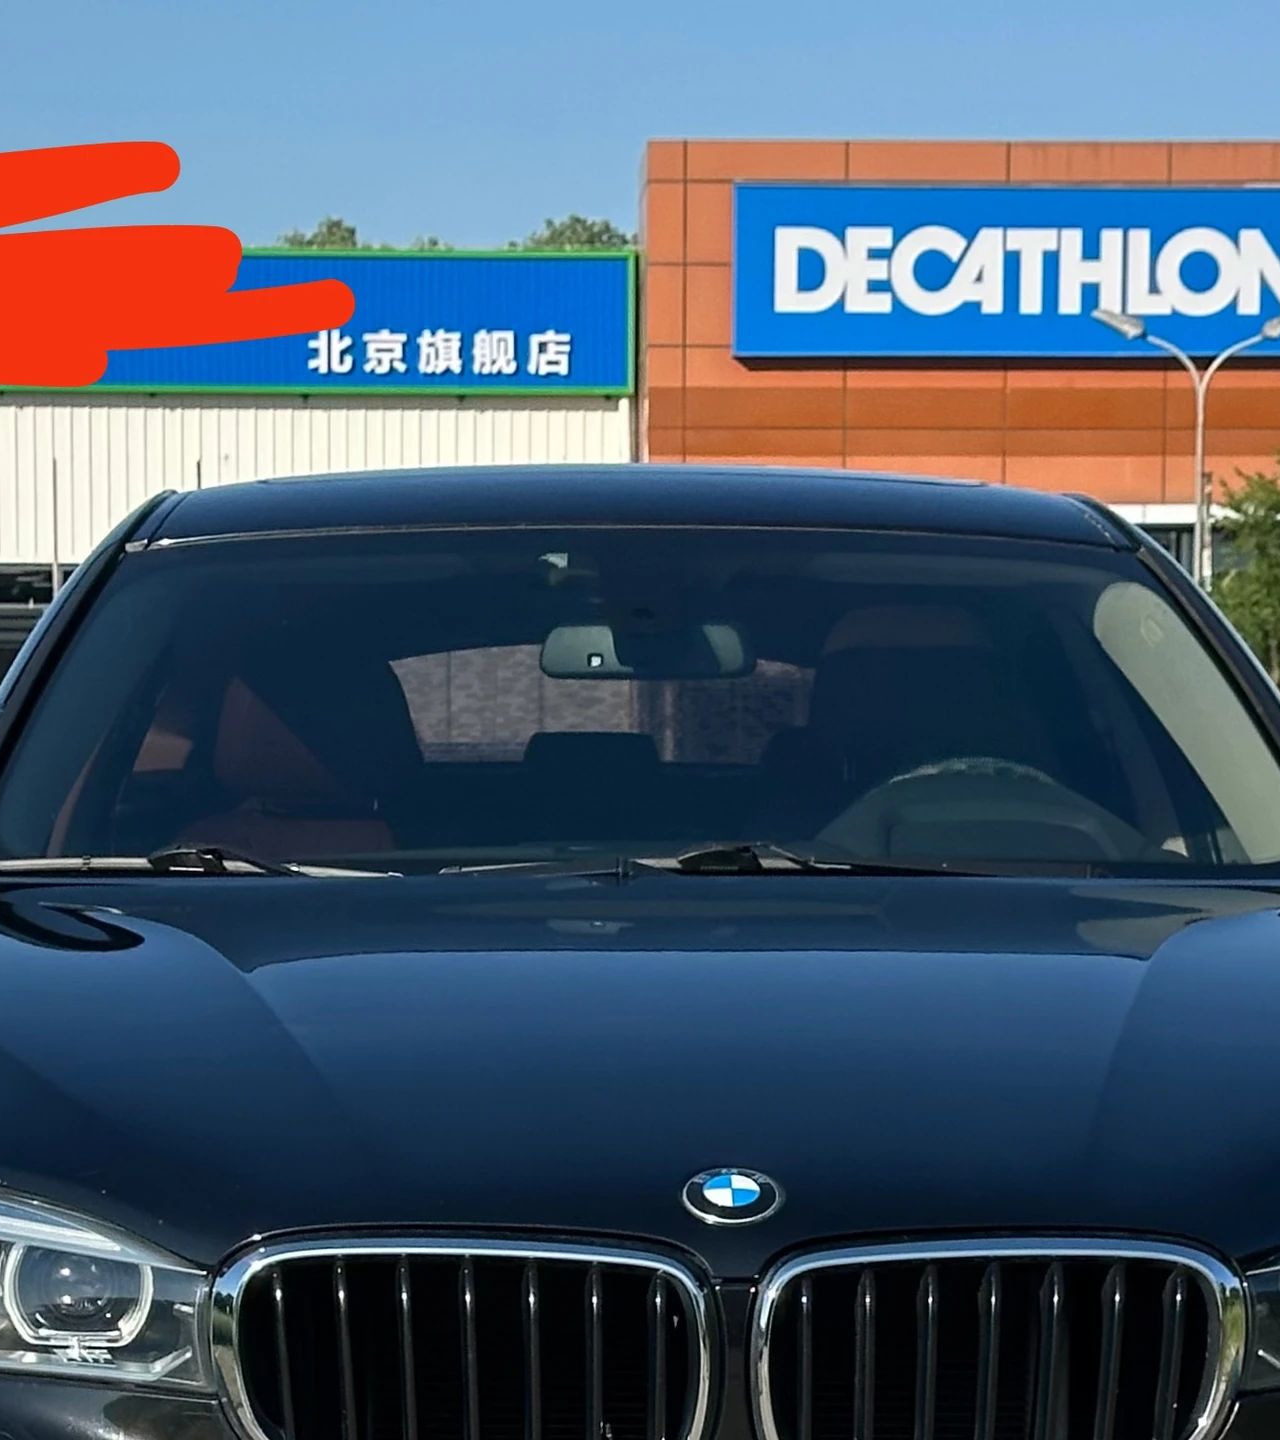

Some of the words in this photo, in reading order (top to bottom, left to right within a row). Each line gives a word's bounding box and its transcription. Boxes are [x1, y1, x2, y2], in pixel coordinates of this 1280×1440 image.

[307, 328, 574, 377] 北京旗舰店
